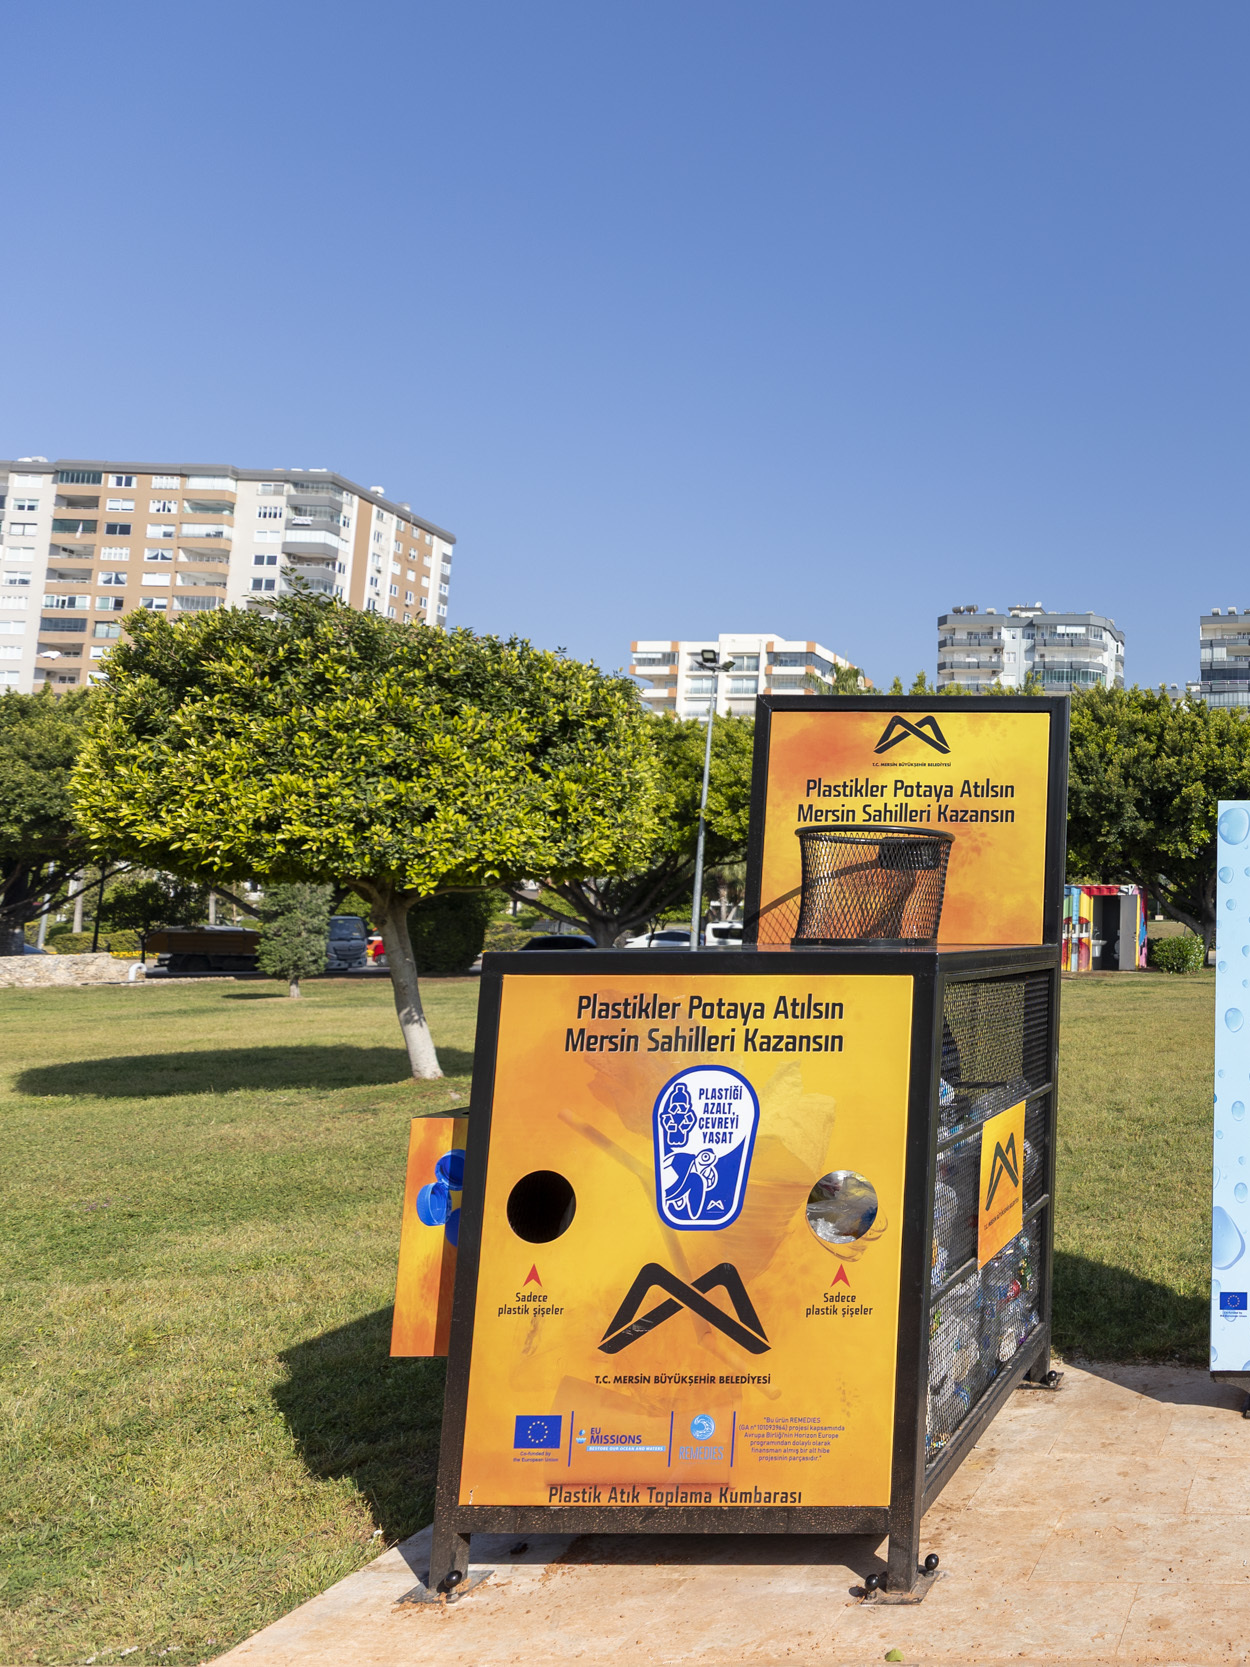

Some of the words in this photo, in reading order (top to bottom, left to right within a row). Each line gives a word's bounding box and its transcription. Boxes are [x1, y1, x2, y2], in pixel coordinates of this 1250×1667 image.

[806, 778, 887, 798] Plastikler
[894, 779, 953, 802] Potaya
[960, 778, 1015, 798] Atılsın
[797, 804, 856, 823] Mersin
[862, 803, 931, 823] Sahilleri
[938, 804, 1015, 823] Kazansın
[577, 994, 681, 1020] Plastikler
[688, 995, 765, 1026] Potaya
[773, 993, 844, 1020] Atılsın
[565, 1027, 639, 1052] Mersin
[647, 1026, 736, 1052] Sahilleri
[743, 1028, 844, 1053] Kazansın
[699, 1085, 742, 1100] PLASTİĞİ
[703, 1102, 735, 1116] AZALT,
[698, 1115, 739, 1130] ÇEVREYİ
[702, 1131, 733, 1144] YAŞAT
[516, 1292, 548, 1302] Sadece
[824, 1292, 856, 1303] Sadece
[498, 1304, 529, 1317] plastik
[533, 1304, 564, 1317] şişeler
[806, 1304, 838, 1318] plastik
[842, 1304, 873, 1317] şişeler
[595, 1375, 610, 1384] T.C.
[613, 1373, 650, 1384] MERSİN
[654, 1373, 715, 1386] BÜYÜKŞEHİR
[719, 1373, 771, 1384] BELEDİYESİ
[590, 1435, 642, 1444] MISSIONS
[679, 1446, 724, 1460] REMEDIES
[549, 1485, 601, 1503] Plastik
[608, 1486, 640, 1503] Atık
[647, 1486, 712, 1507] Toplama
[719, 1486, 802, 1504] Kumbarası
